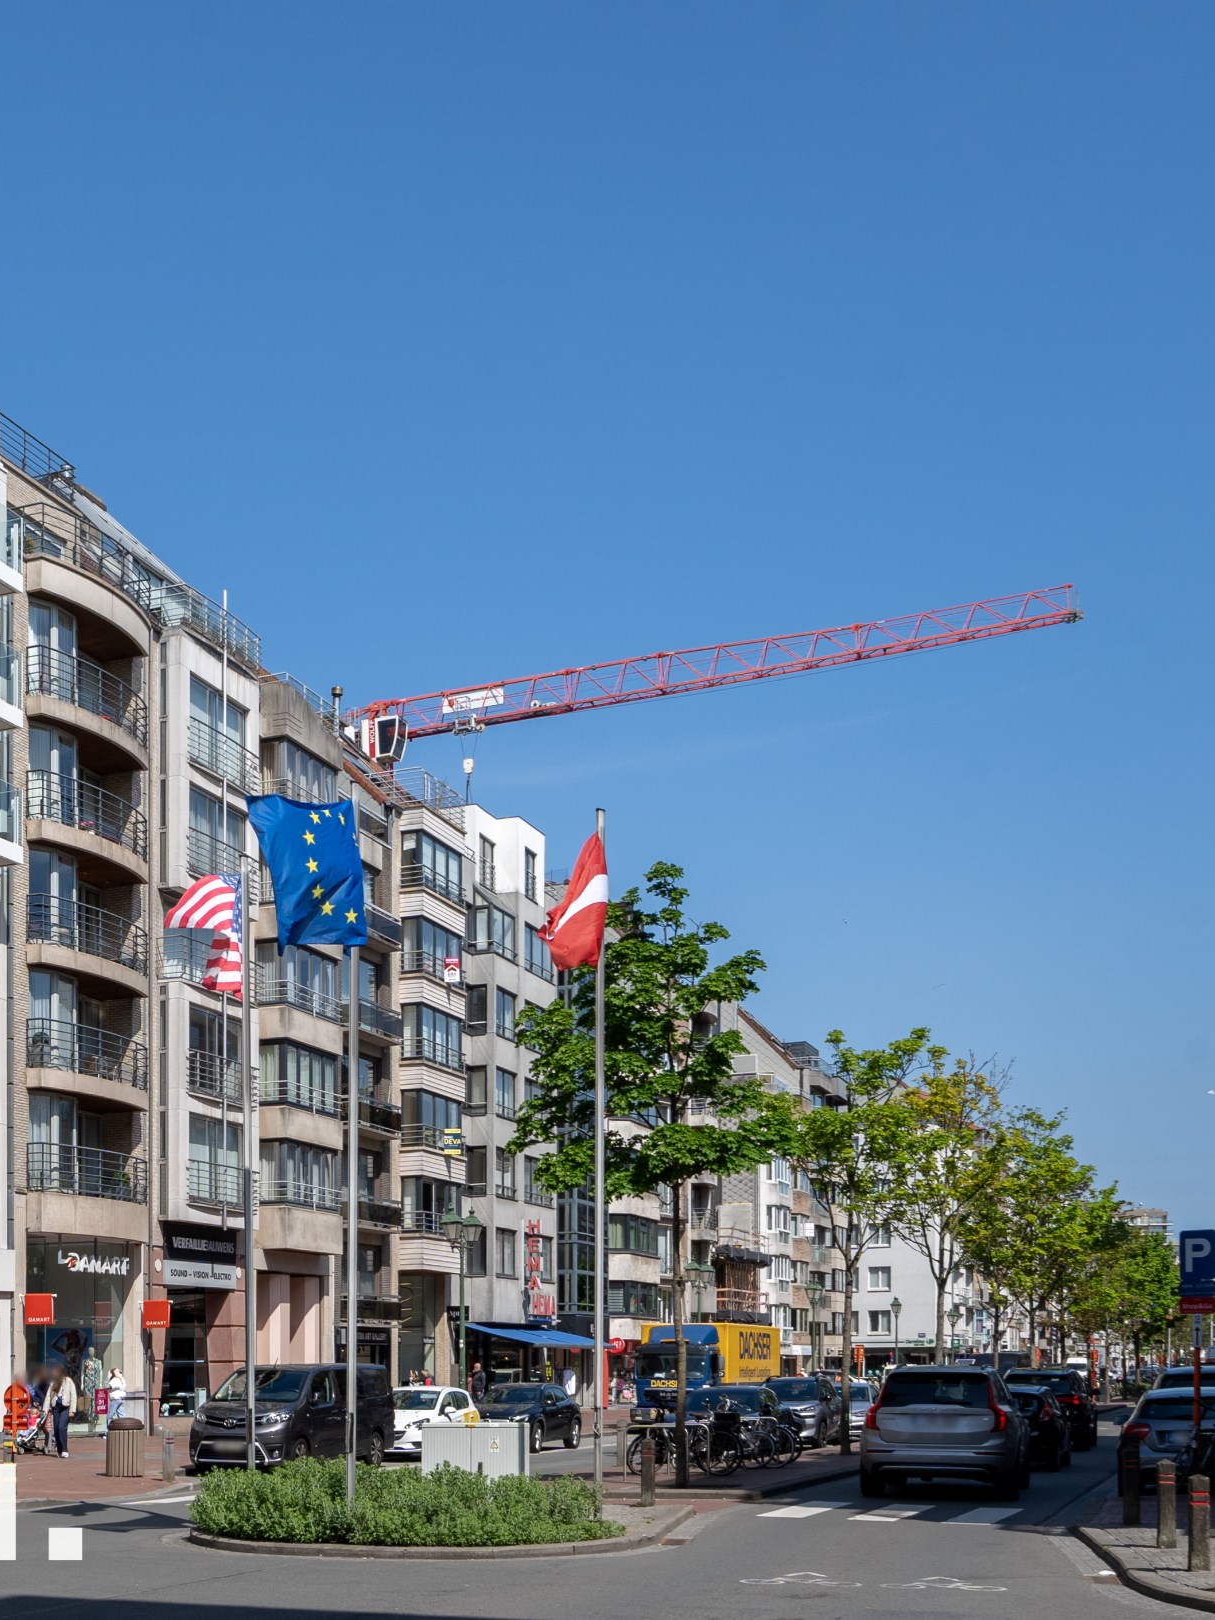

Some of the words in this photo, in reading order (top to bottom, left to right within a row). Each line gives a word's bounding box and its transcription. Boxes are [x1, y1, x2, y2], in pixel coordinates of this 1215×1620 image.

[528, 1219, 541, 1290] HEMA
[1185, 1238, 1212, 1272] P
[170, 1269, 188, 1277] SOUND
[193, 1271, 209, 1279] VISION
[213, 1272, 232, 1280] ELECTRO
[531, 1294, 556, 1316] HEMA
[739, 1331, 771, 1359] DACHSER
